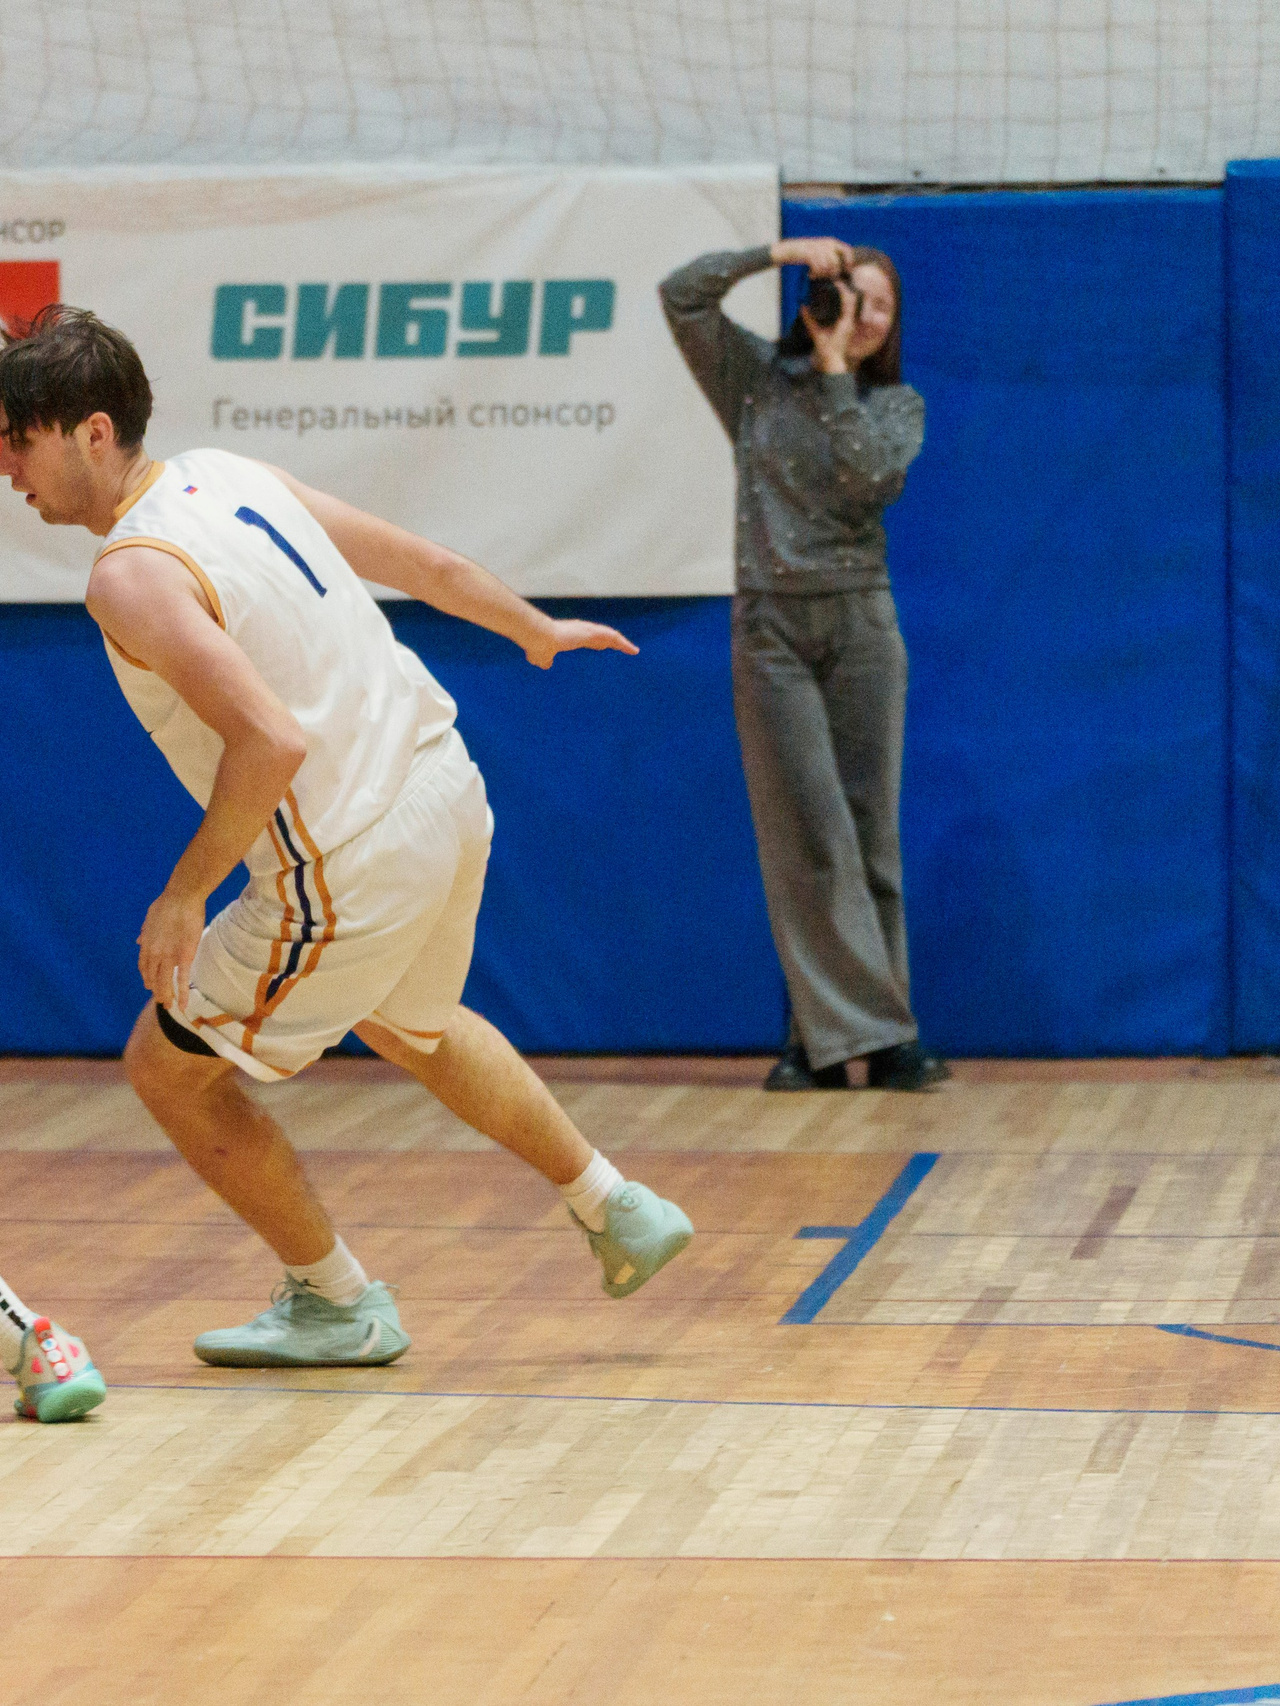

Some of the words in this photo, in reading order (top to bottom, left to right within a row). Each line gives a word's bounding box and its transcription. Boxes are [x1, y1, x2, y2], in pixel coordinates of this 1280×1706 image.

[210, 278, 616, 361] СИБУР
[212, 397, 455, 437] Генеральный
[467, 399, 616, 433] спонсор
[234, 505, 328, 598] 1
